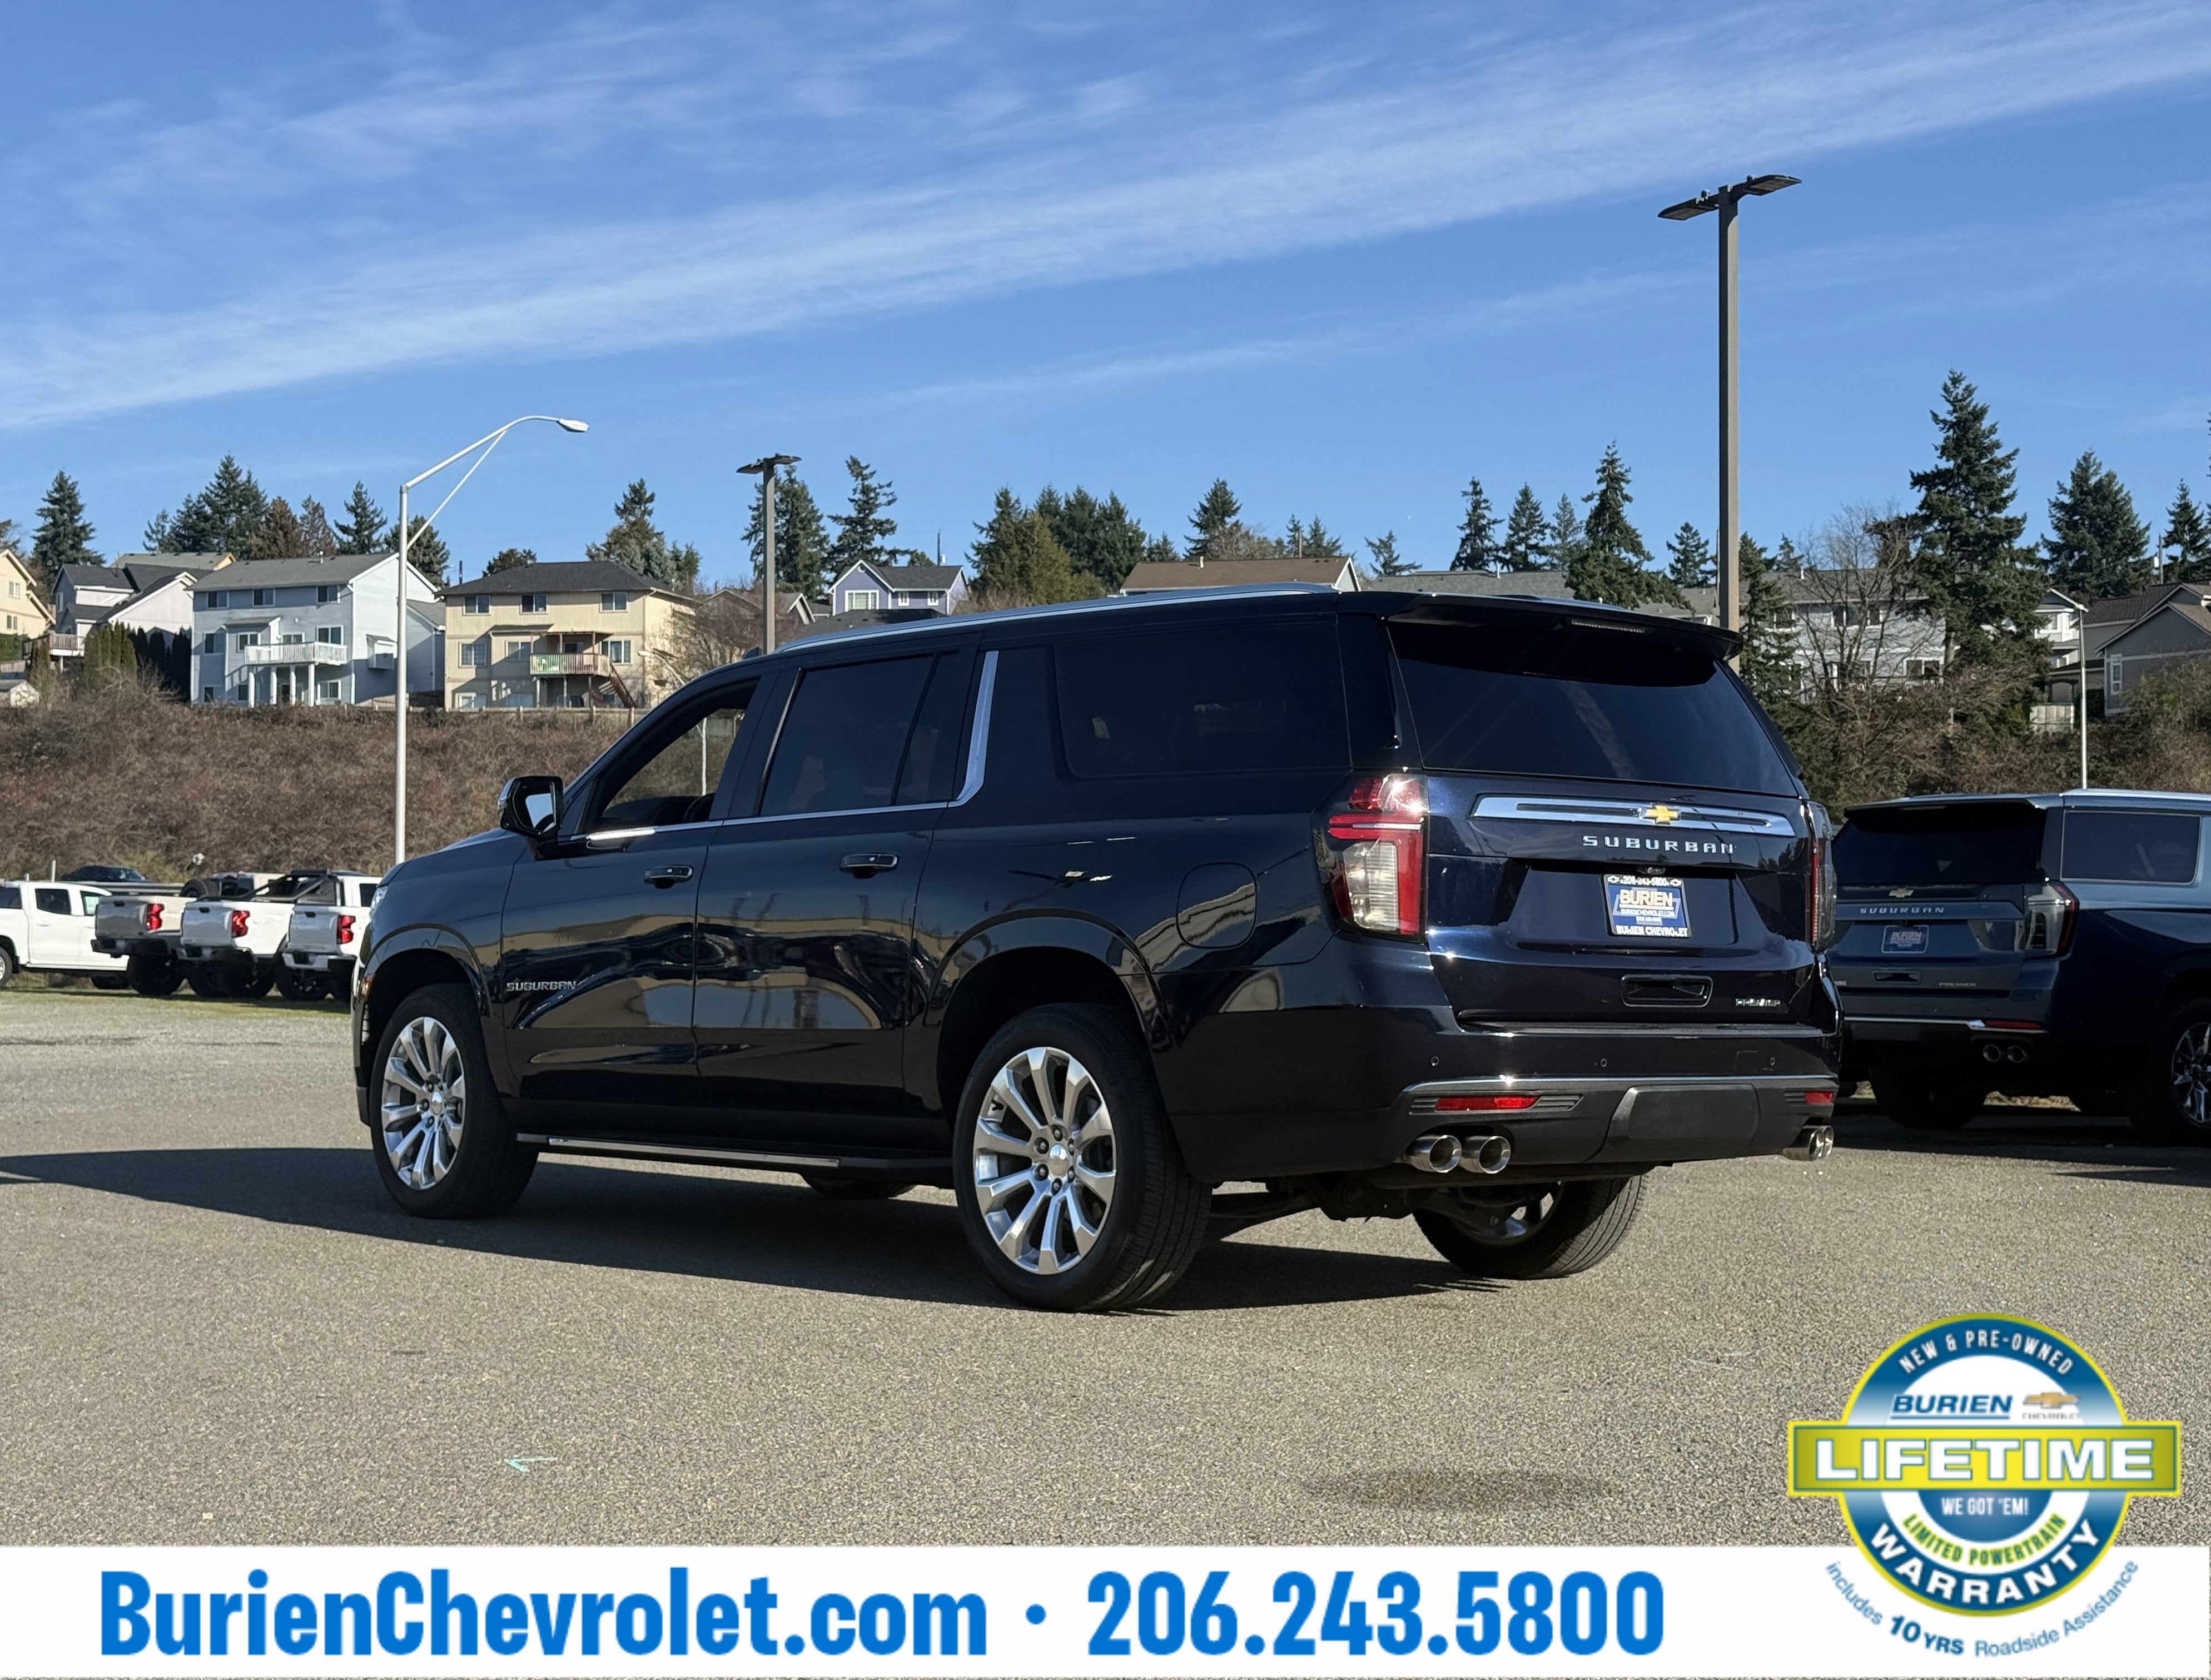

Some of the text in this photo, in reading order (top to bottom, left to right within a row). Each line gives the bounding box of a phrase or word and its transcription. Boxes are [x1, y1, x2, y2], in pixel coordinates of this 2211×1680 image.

[1582, 835, 1734, 854] SUBURBAN
[1619, 889, 1673, 907] BURIEN
[506, 981, 576, 992] SUBURBAN
